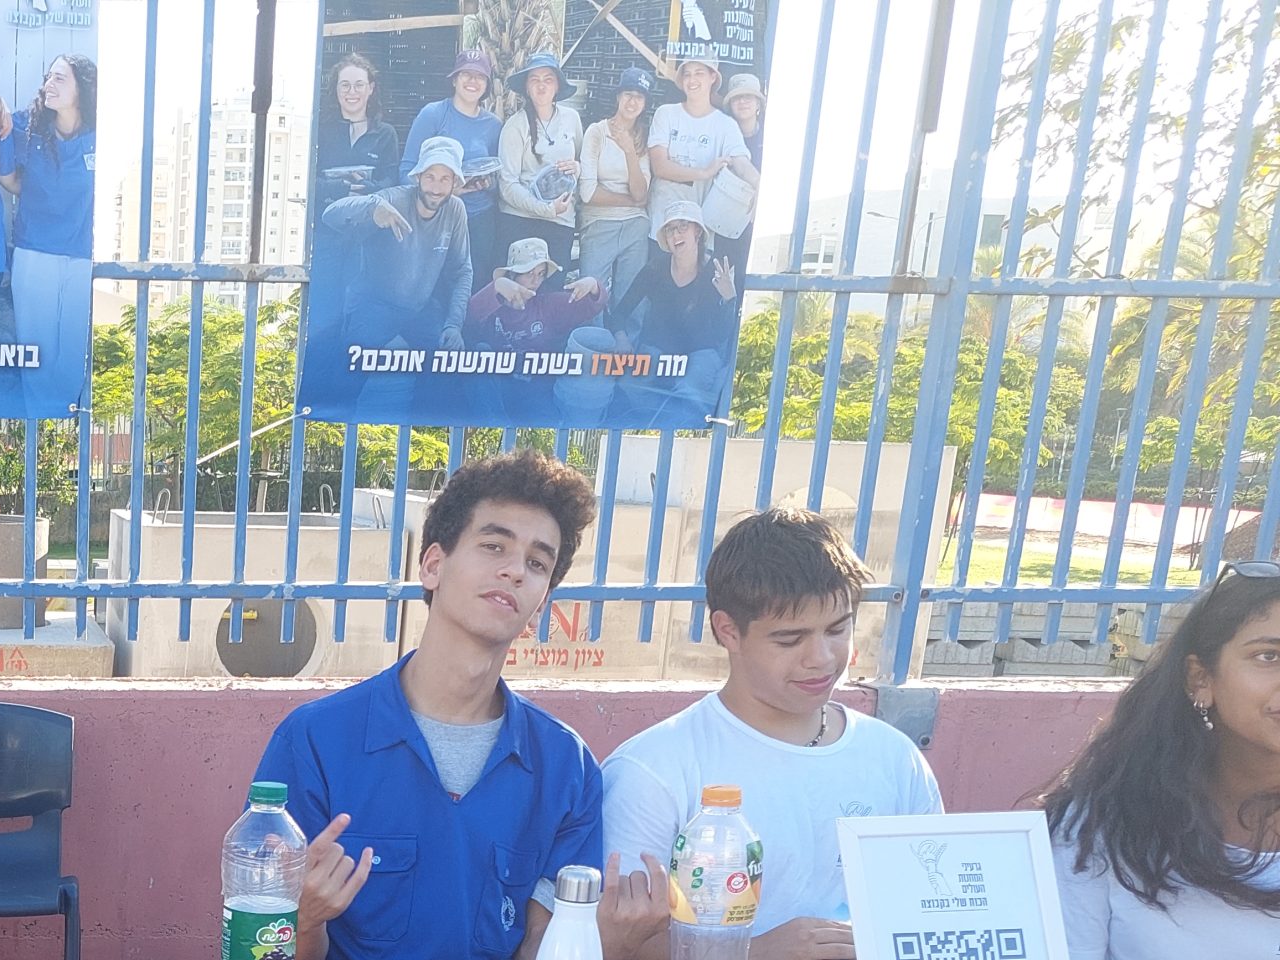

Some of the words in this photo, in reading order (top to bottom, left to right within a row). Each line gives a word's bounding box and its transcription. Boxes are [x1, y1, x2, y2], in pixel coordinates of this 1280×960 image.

[723, 10, 754, 27] המחנות
[726, 24, 754, 42] העולים
[666, 41, 706, 58] בקבוצה
[709, 41, 730, 57] שלי
[730, 44, 754, 60] הכוח
[348, 345, 426, 373] אתכם?
[431, 349, 517, 375] שתשנה
[522, 351, 583, 375] בשנה
[590, 352, 652, 377] תיצרו
[656, 353, 689, 377] מה
[522, 647, 569, 667] מוצרי
[574, 647, 605, 672] ציון
[961, 883, 986, 894] העולים
[920, 898, 951, 910] בקבוצה
[951, 896, 967, 908] שלי
[968, 897, 988, 907] הכוח
